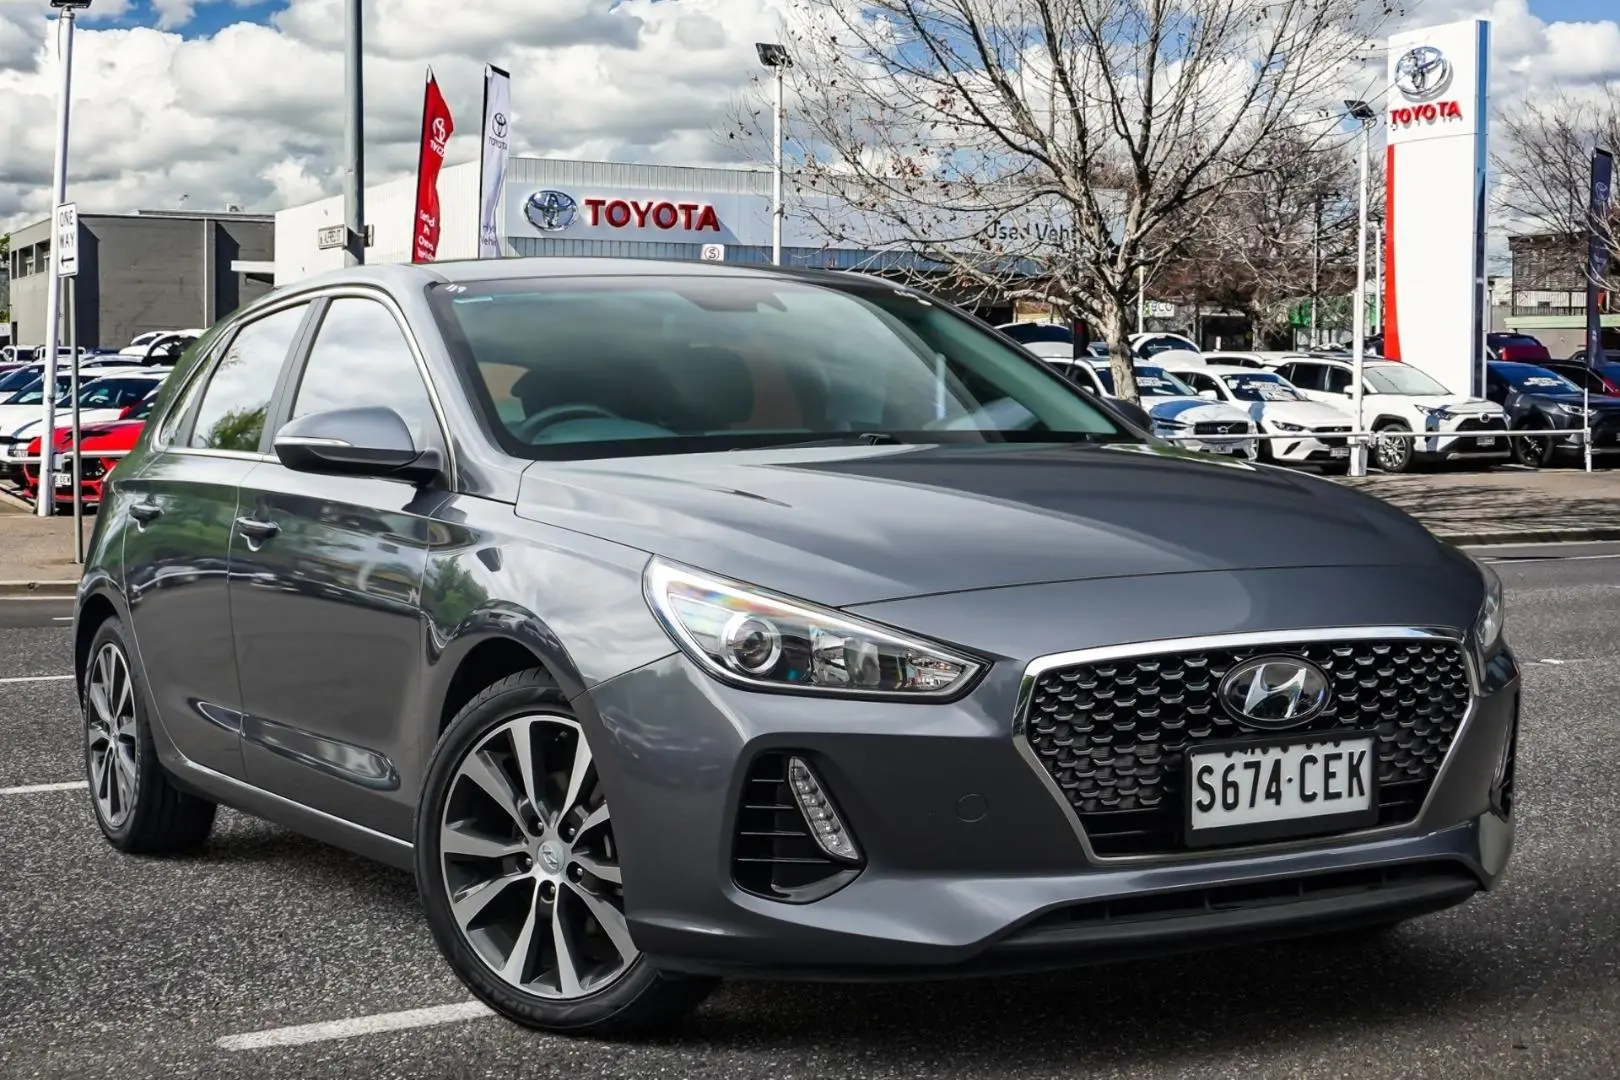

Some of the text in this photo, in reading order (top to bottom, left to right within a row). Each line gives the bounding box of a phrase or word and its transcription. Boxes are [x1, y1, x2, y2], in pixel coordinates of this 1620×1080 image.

[1389, 101, 1462, 125] TOYOTA
[59, 208, 74, 227] ONE
[585, 199, 721, 232] TOYOTA
[59, 231, 75, 248] WAY
